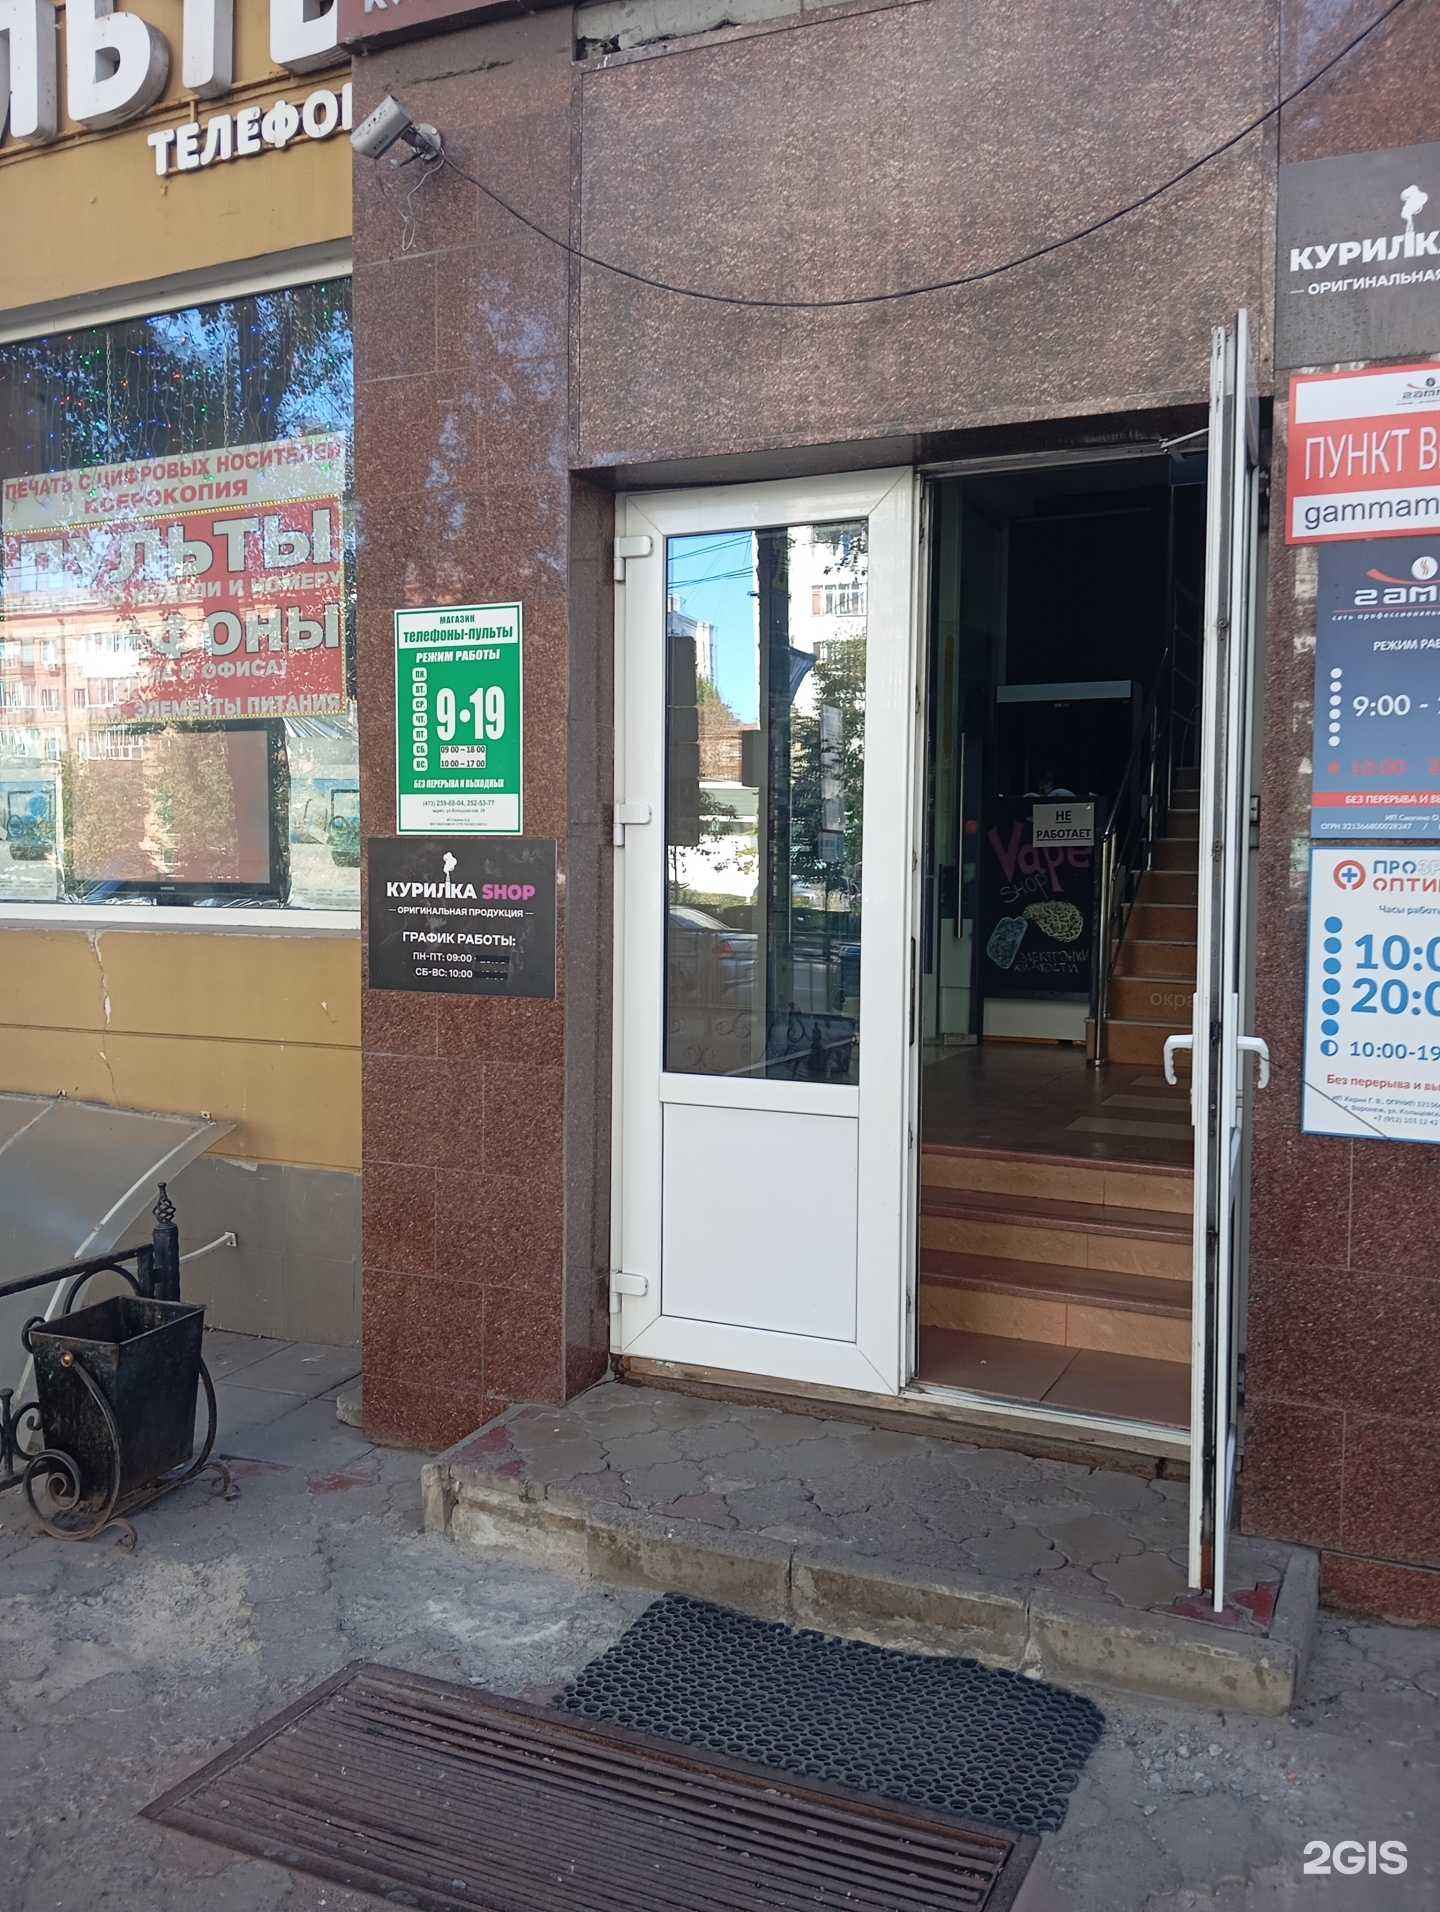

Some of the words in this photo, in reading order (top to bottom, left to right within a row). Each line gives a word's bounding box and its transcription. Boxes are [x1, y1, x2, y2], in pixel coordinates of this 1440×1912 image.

[147, 83, 351, 176] ТЕЛЕФО
[1290, 231, 1440, 272] КУРИЛК
[1305, 429, 1410, 480] ПУНКТ
[5, 478, 73, 500] ПЕЧАТЬ
[96, 461, 211, 489] ЦИФРОВЫХ
[84, 480, 248, 515] КСЕРОКОПИЯ
[229, 580, 245, 597] И
[251, 570, 344, 595] НОМЕРУ
[440, 615, 475, 624] МАГАЗИН
[1374, 640, 1418, 651] РЕЖИМ
[416, 650, 453, 663] РЕЖИМ
[455, 649, 500, 661] РАБОТЫ
[133, 696, 241, 718] ЭЛЕМЕНТЫ
[247, 693, 340, 714] ПИТАНИЯ
[1352, 694, 1411, 717] 9:00
[1056, 811, 1072, 821] НЕ
[1037, 828, 1090, 839] РАБОТАЕТ
[387, 882, 477, 899] КУРИЛКА
[482, 884, 536, 900] SHOP
[1373, 877, 1440, 892] ОПТИ
[398, 906, 467, 916] ОРИГИНАЛЬНАЯ
[469, 909, 523, 919] ПРОДУКЦИЯ
[1379, 904, 1405, 914] Часы
[402, 931, 455, 944] ГРАФИК
[458, 934, 516, 946] РАБОТЫ:
[413, 951, 445, 961] ПН-ПТ:
[446, 953, 473, 963] 09:00
[416, 968, 448, 977] СБ-ВС:
[449, 969, 473, 978] 10:00
[1327, 1074, 1347, 1085] Без
[1351, 1078, 1410, 1090] перерыва
[1414, 1082, 1421, 1090] и
